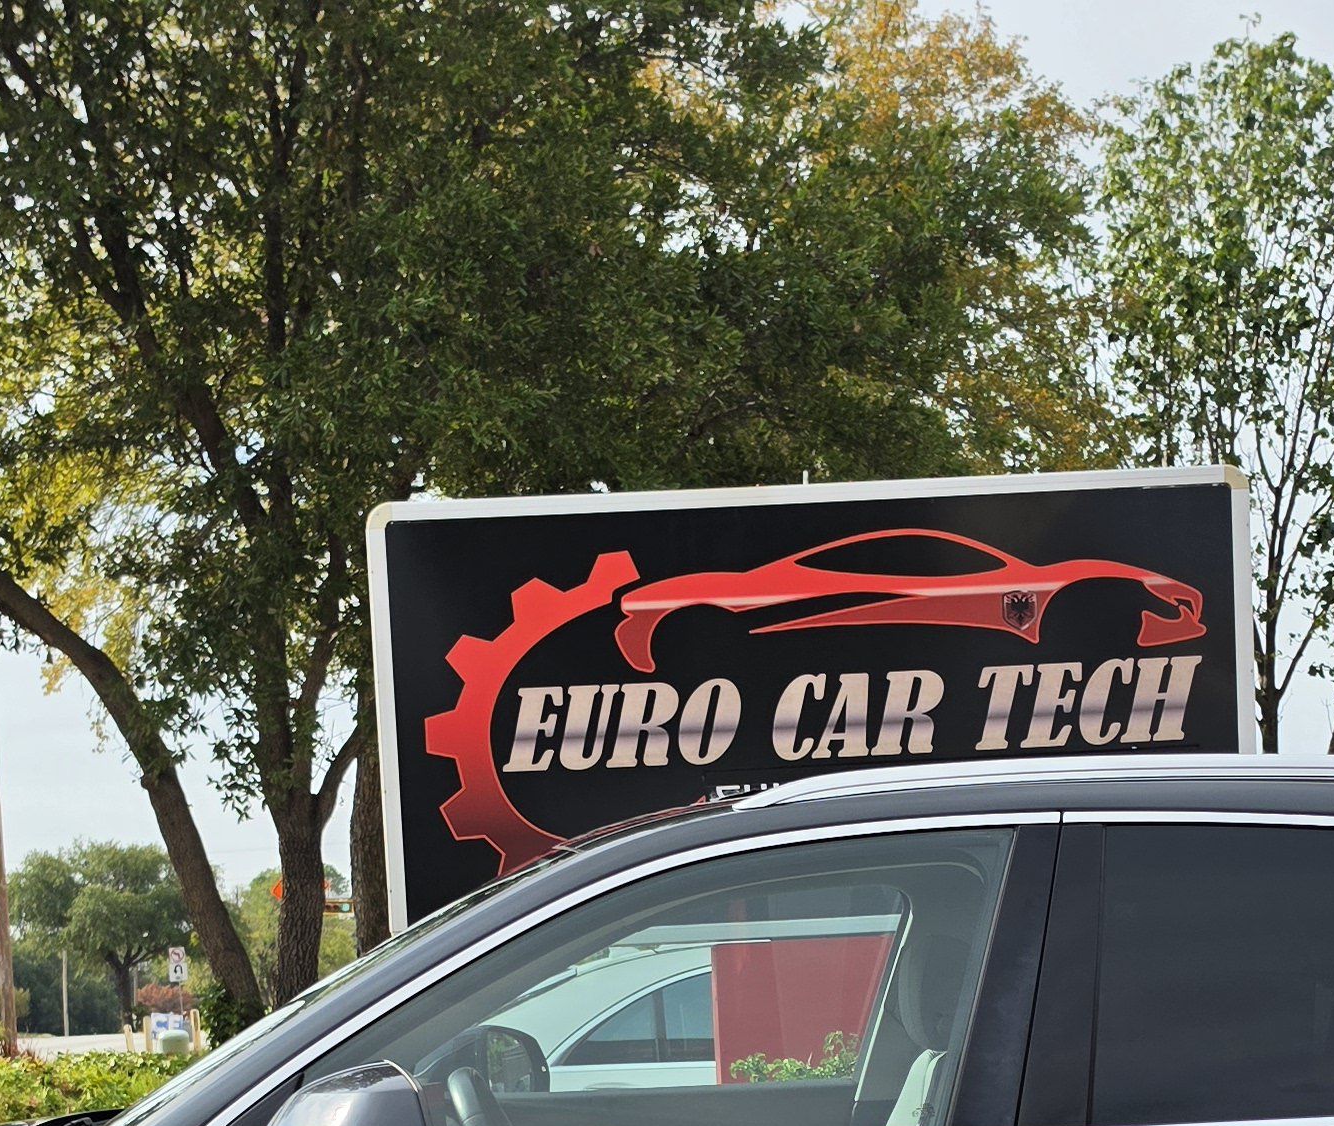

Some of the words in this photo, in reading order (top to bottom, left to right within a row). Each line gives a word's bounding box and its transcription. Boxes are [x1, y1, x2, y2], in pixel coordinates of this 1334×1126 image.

[503, 678, 741, 772] EURO
[772, 670, 944, 761] CAR
[975, 656, 1202, 750] TECH
